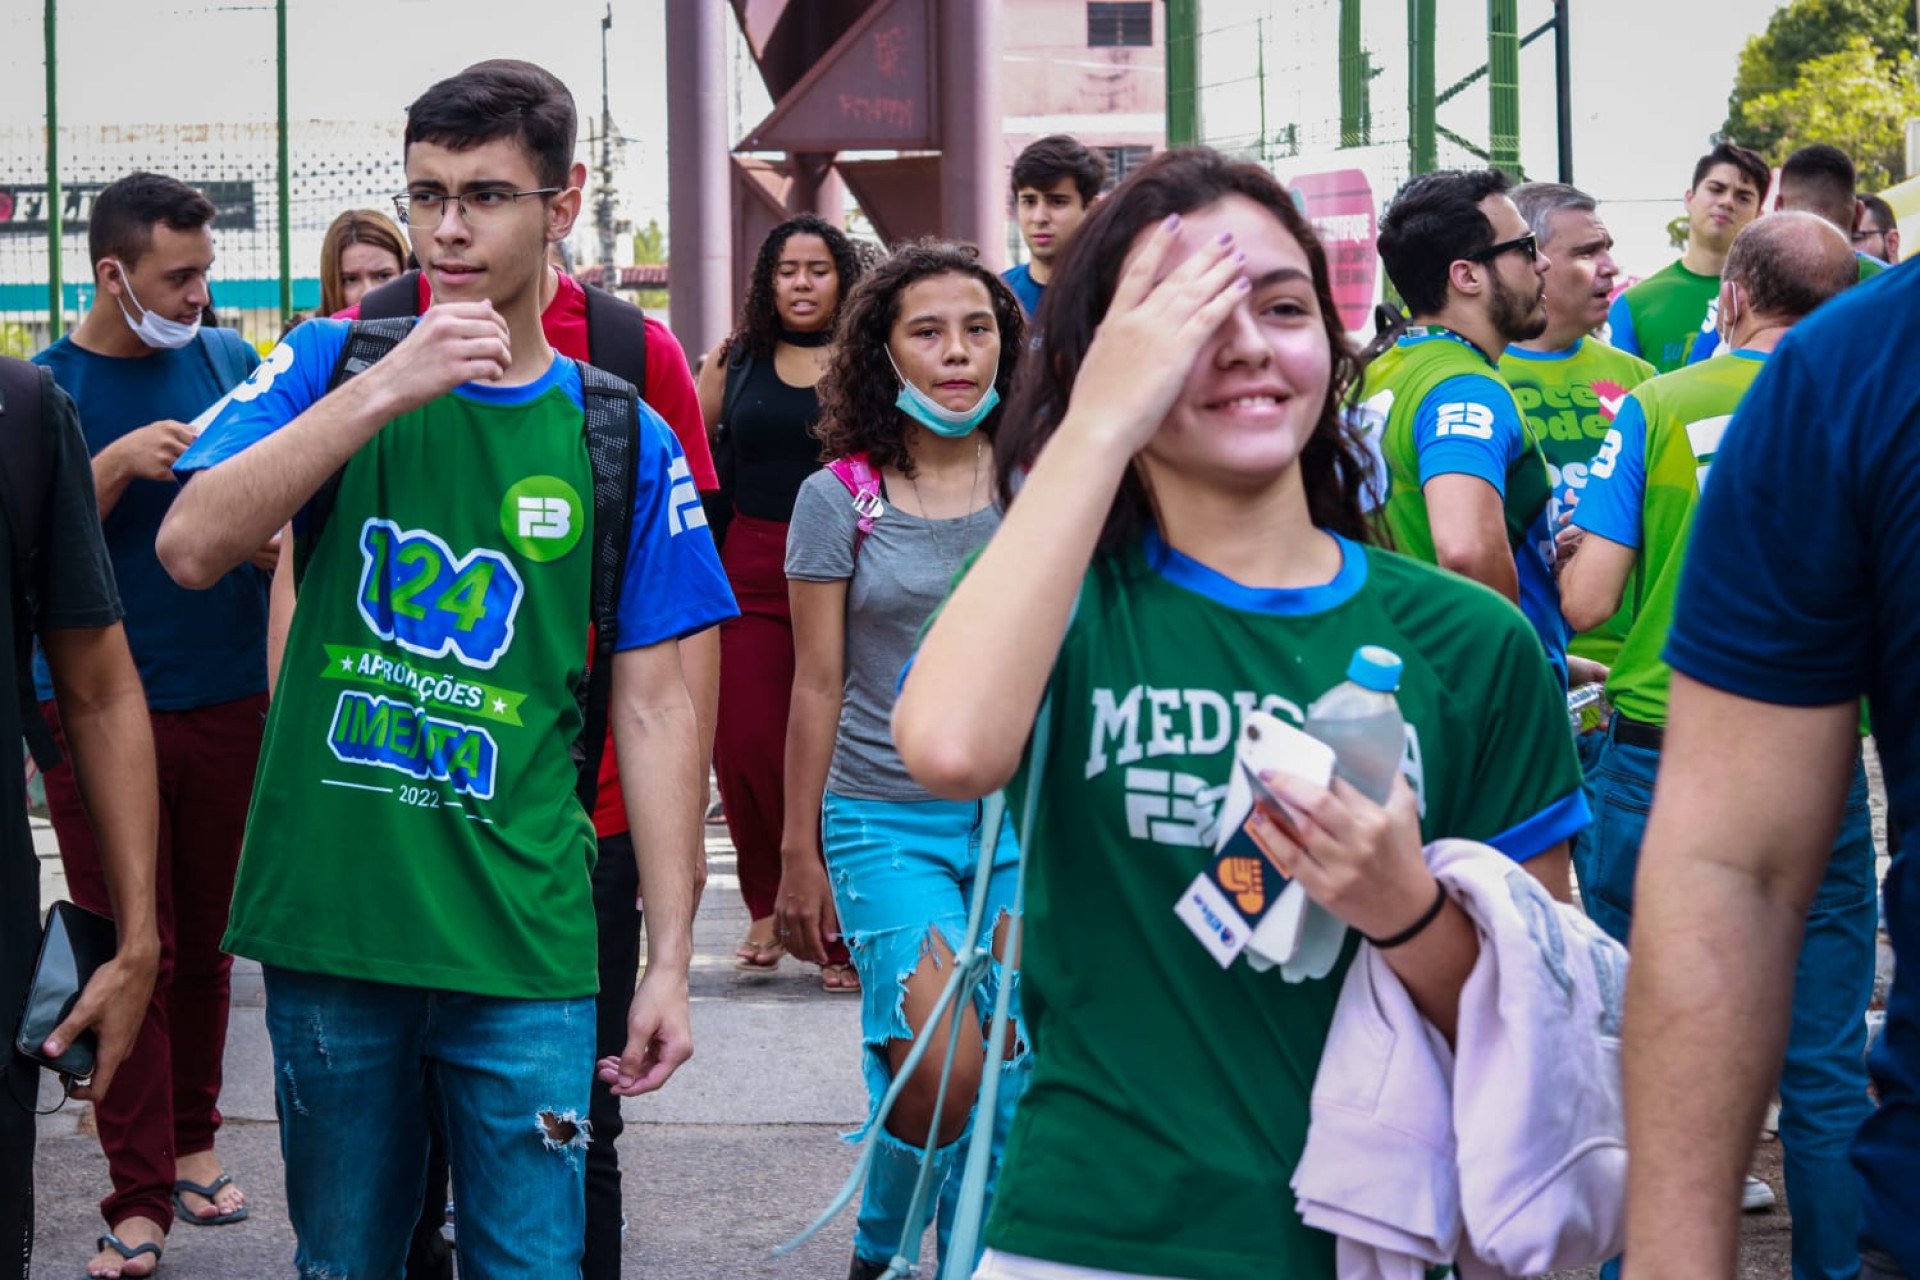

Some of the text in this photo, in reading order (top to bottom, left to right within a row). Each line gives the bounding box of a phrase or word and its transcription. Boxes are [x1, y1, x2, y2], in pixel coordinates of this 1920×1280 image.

[1511, 384, 1600, 409] ocê
[1526, 410, 1611, 441] ode
[518, 497, 571, 539] FB
[363, 528, 503, 638] 124
[357, 653, 483, 708] APROAÇÕES
[1085, 685, 1426, 820] MEDIA
[399, 785, 440, 808] 2022
